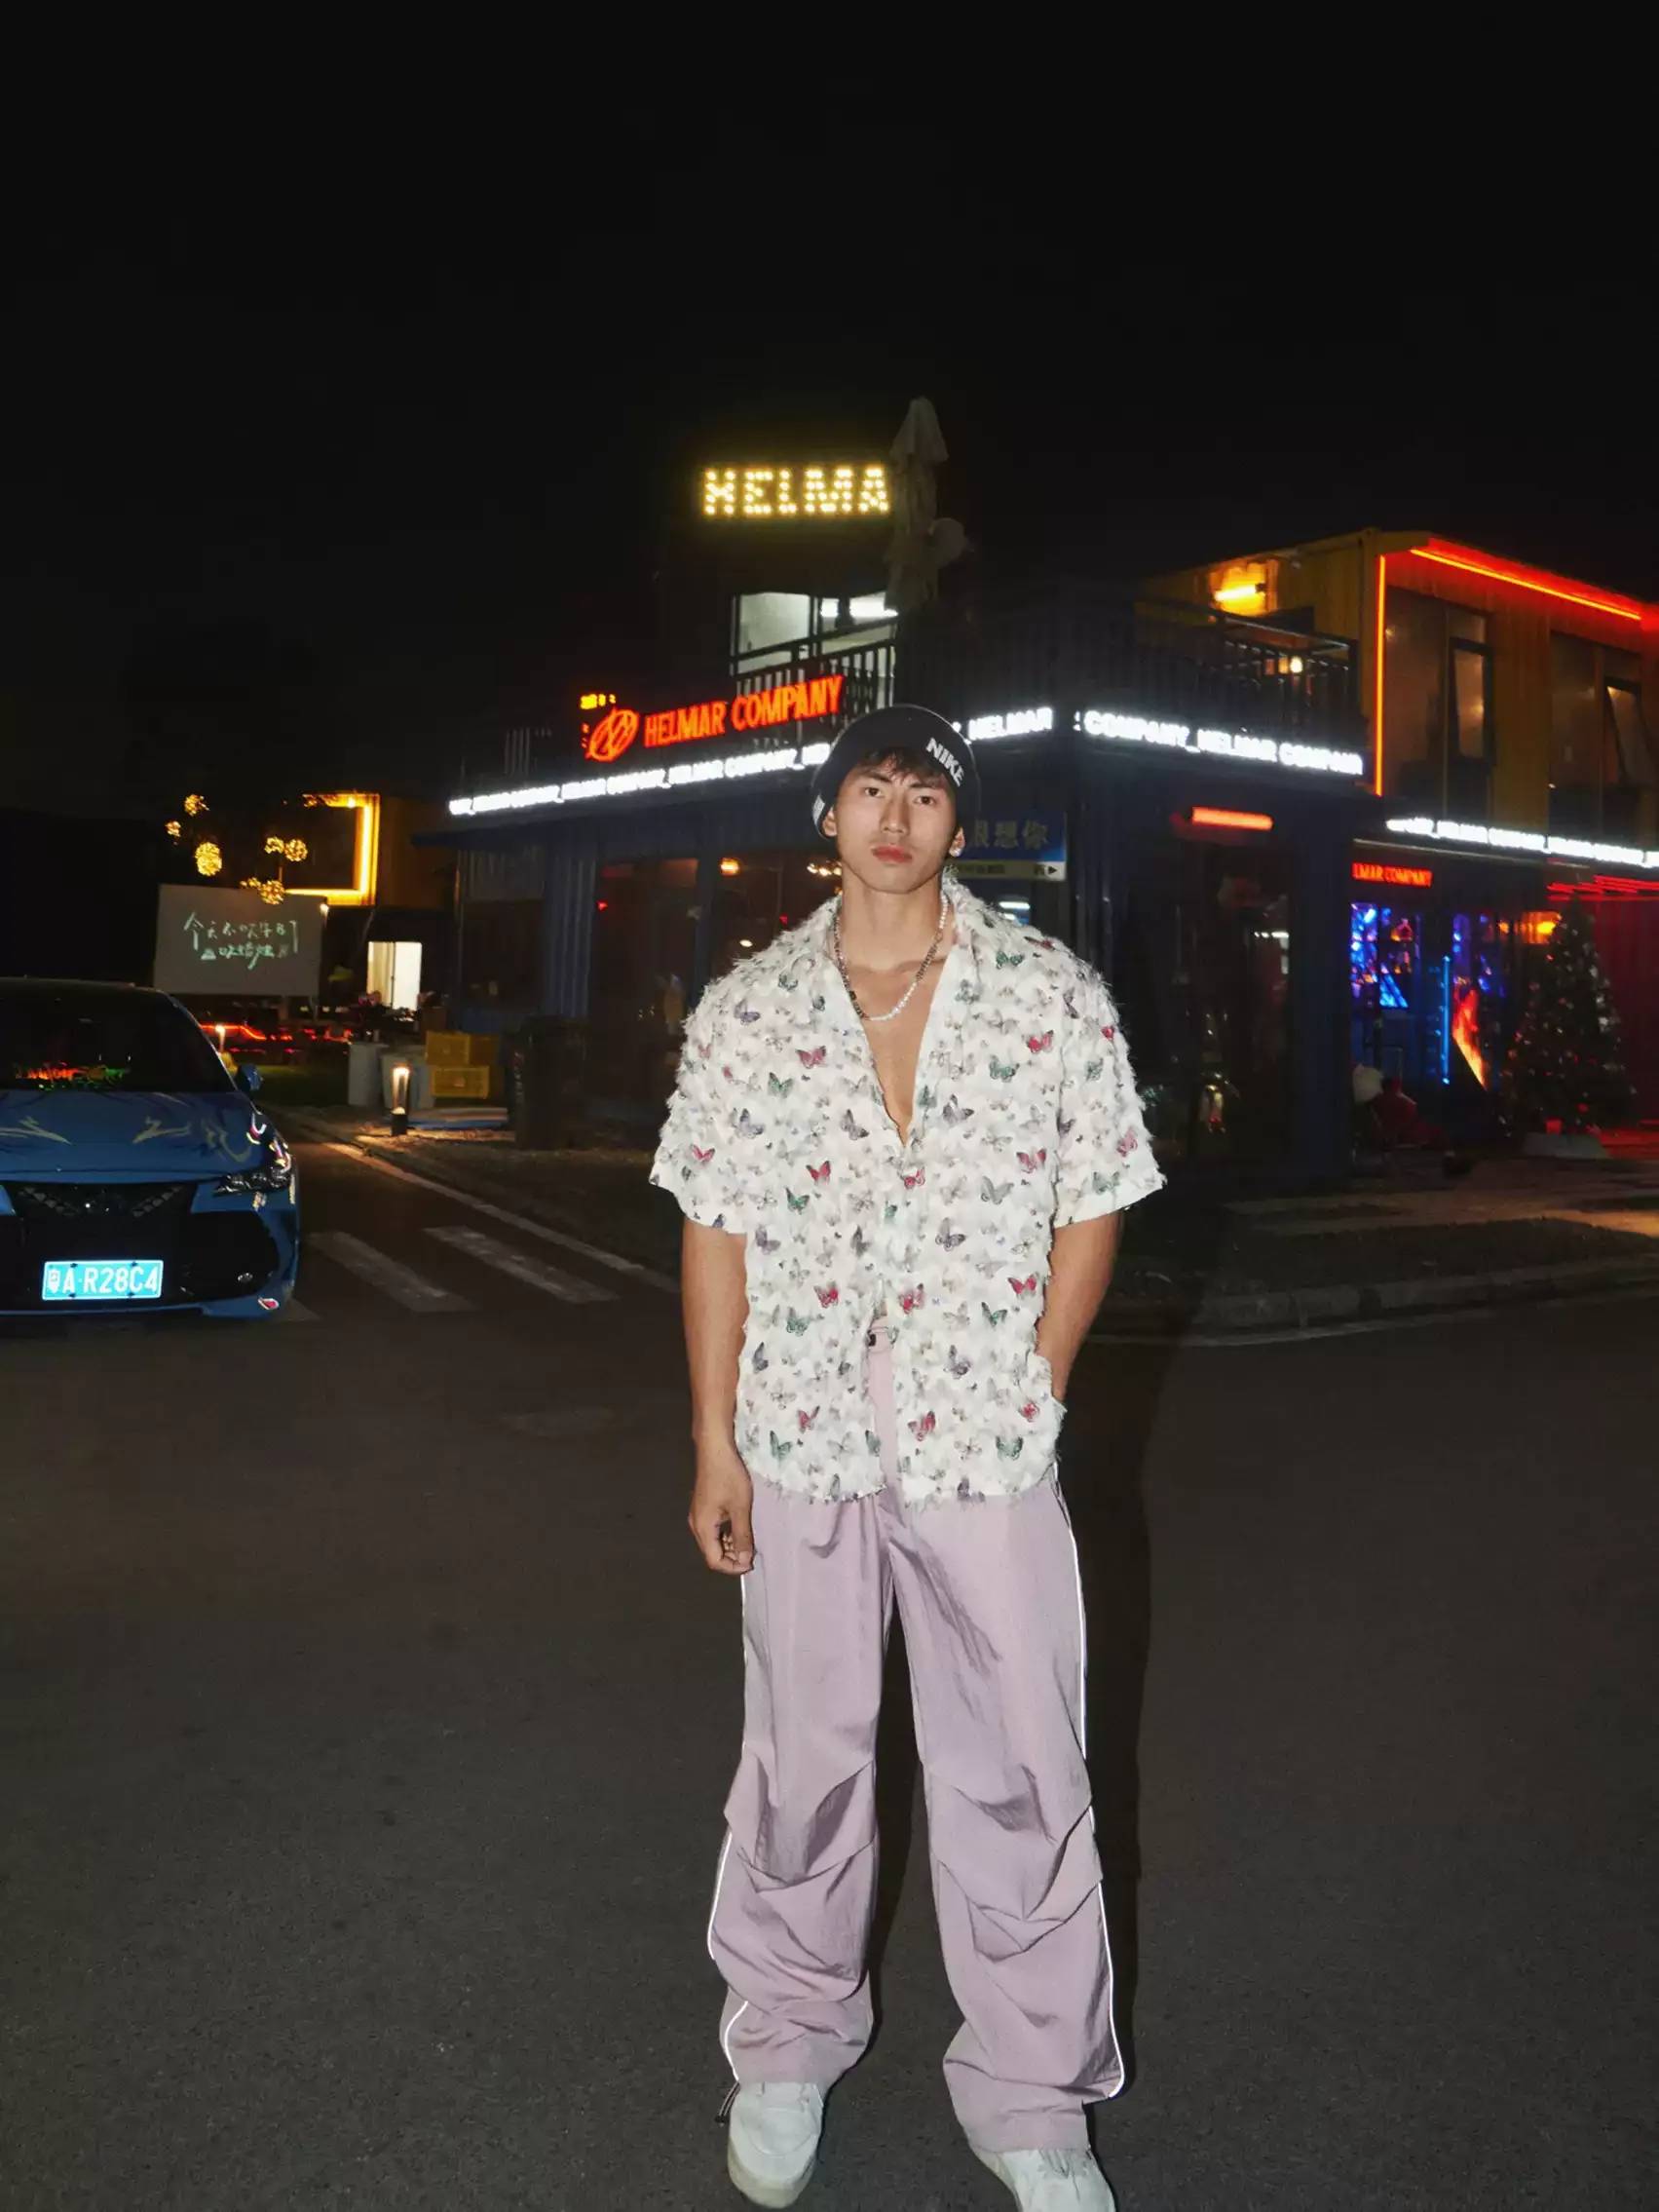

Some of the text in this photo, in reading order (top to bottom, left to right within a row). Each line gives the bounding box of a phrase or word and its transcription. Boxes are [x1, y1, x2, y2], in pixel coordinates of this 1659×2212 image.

[704, 465, 890, 516] HELMA
[642, 674, 844, 748] HELMAR COMPANY
[925, 737, 965, 787] NIKE
